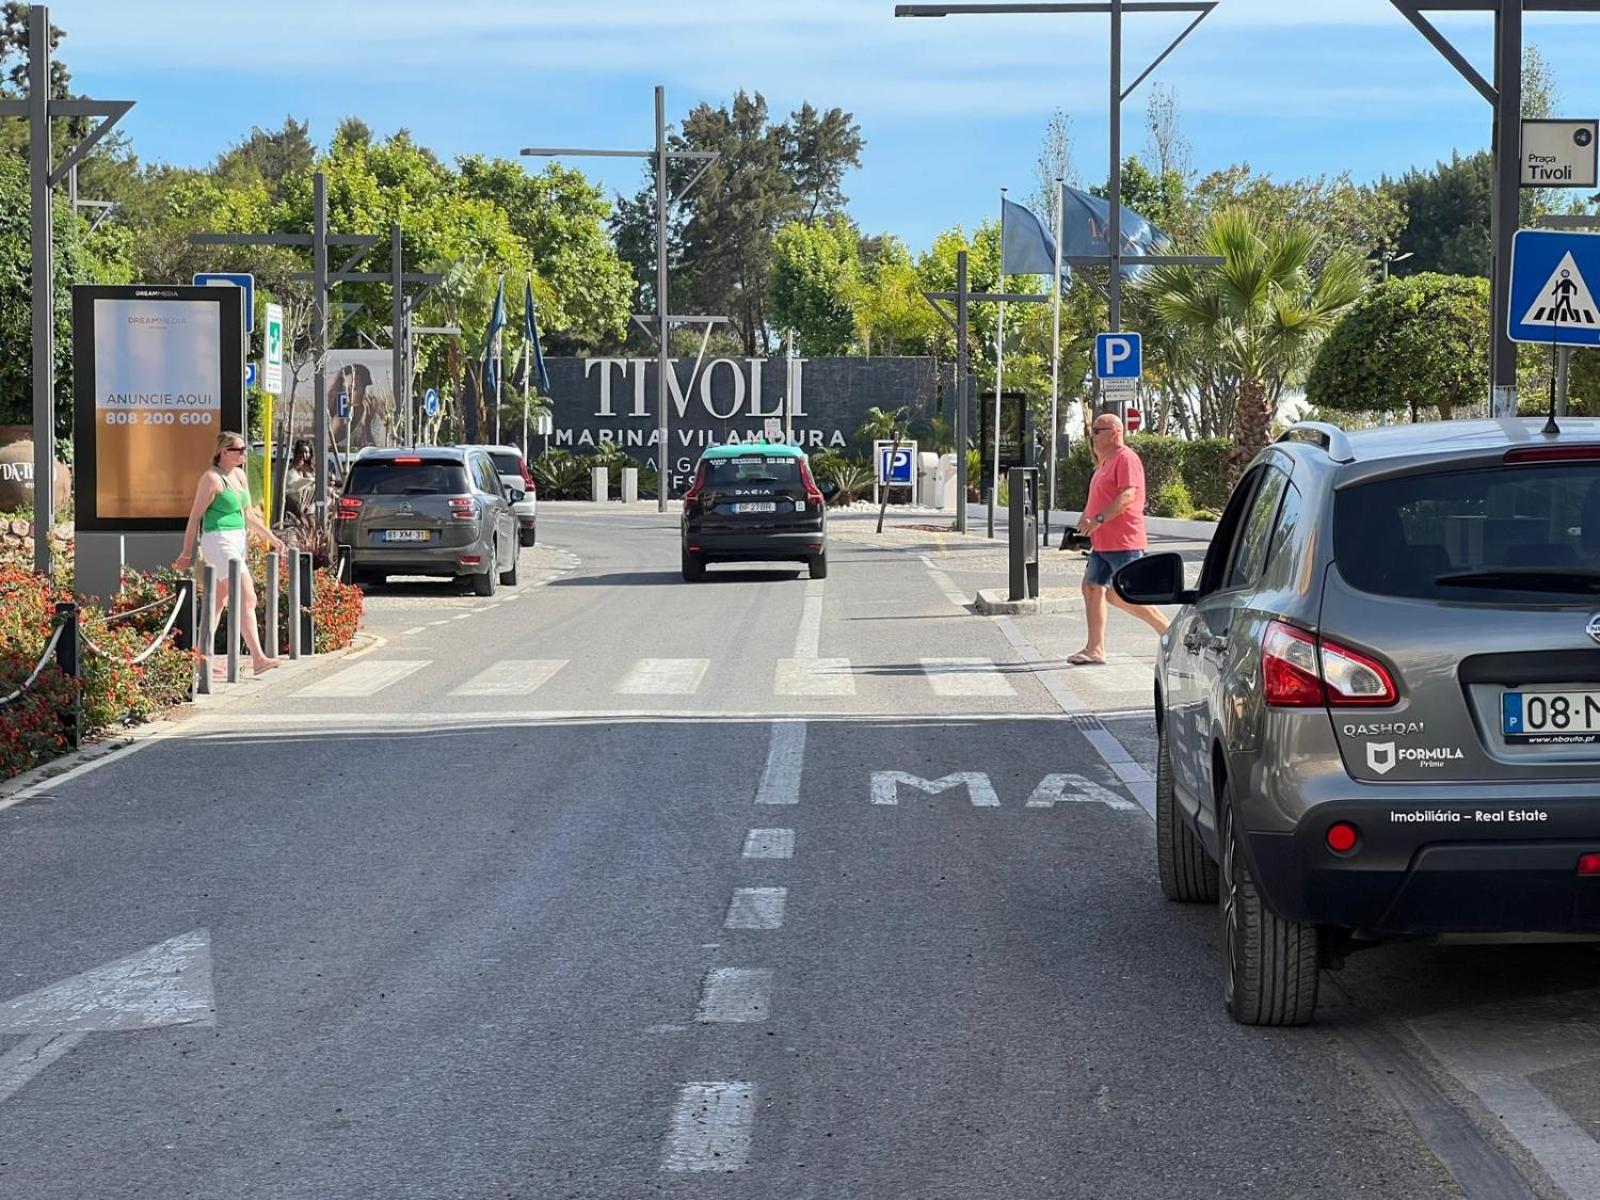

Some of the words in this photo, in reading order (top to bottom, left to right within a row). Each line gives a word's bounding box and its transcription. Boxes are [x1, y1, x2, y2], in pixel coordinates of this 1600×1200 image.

[1528, 153, 1556, 165] Praça
[1528, 165, 1571, 180] Tivoli
[1105, 338, 1131, 375] P
[584, 358, 809, 419] TIVOLI
[106, 393, 172, 405] ANUNCIE
[175, 393, 212, 406] AQUI
[105, 412, 138, 424] 808
[143, 412, 175, 424] 200
[179, 412, 212, 424] 600
[556, 428, 661, 447] MARINA
[1343, 721, 1424, 737] QASHQAI
[1528, 735, 1595, 744] www.nbauto.pt
[1399, 748, 1464, 760] FORMULA
[1419, 760, 1445, 768] Prime
[1390, 810, 1460, 823] Imobiliária
[1476, 810, 1504, 822] Real
[1508, 810, 1548, 822] Estate
